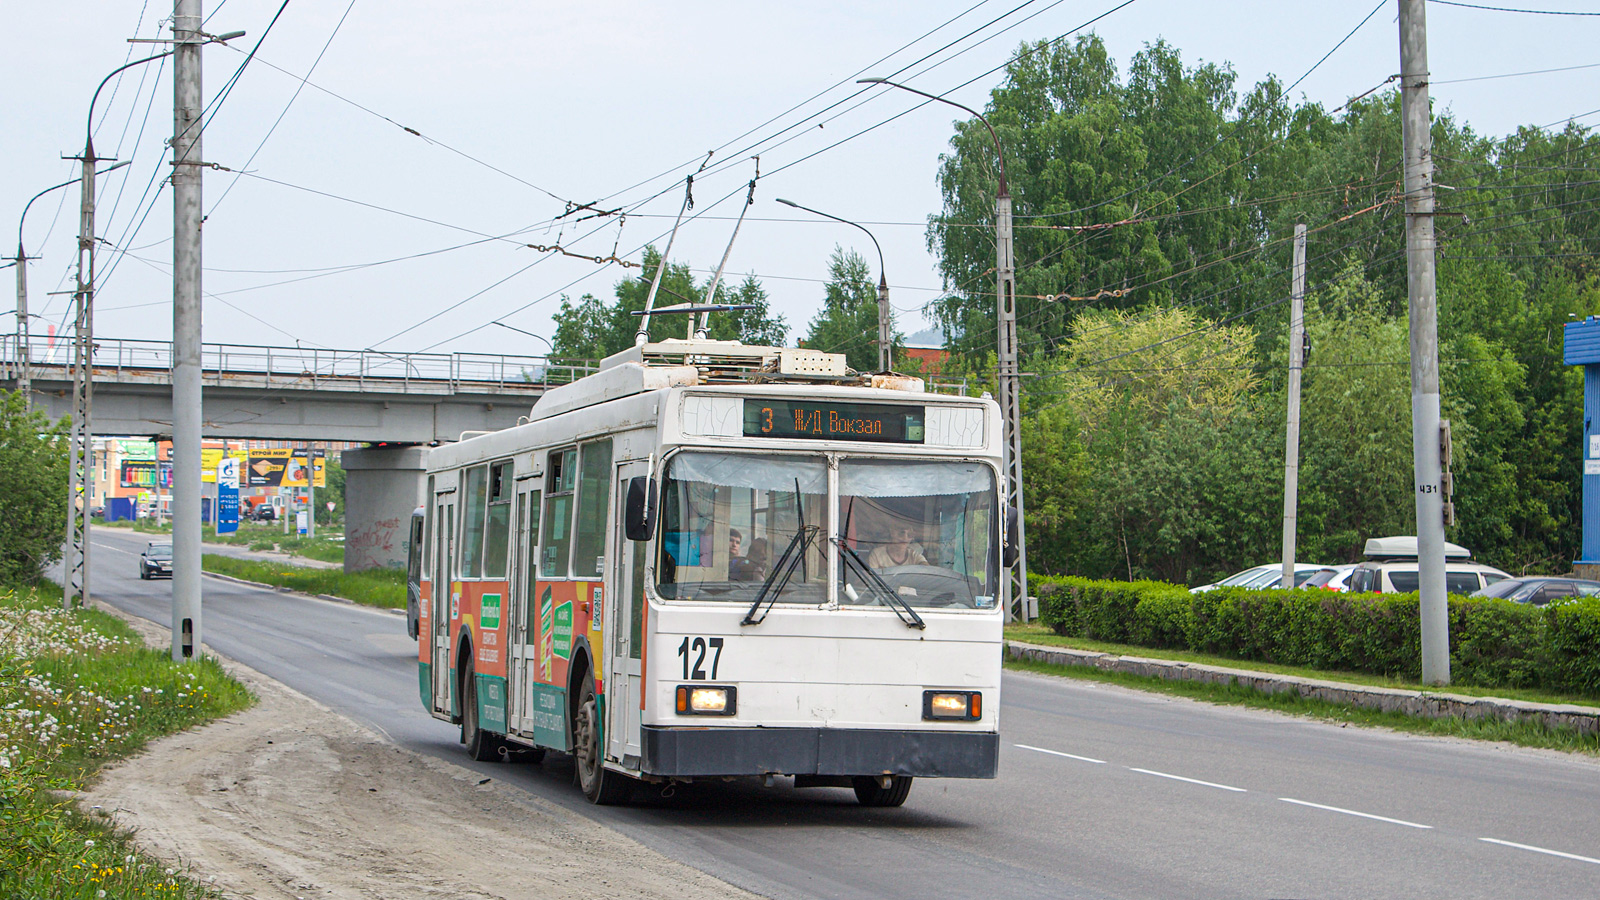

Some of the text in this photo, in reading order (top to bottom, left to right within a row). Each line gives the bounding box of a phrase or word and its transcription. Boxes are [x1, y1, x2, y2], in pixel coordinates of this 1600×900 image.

[761, 407, 882, 435] 3 Ж/Д Вокзал
[1419, 484, 1437, 494] 431
[678, 636, 724, 680] 127
